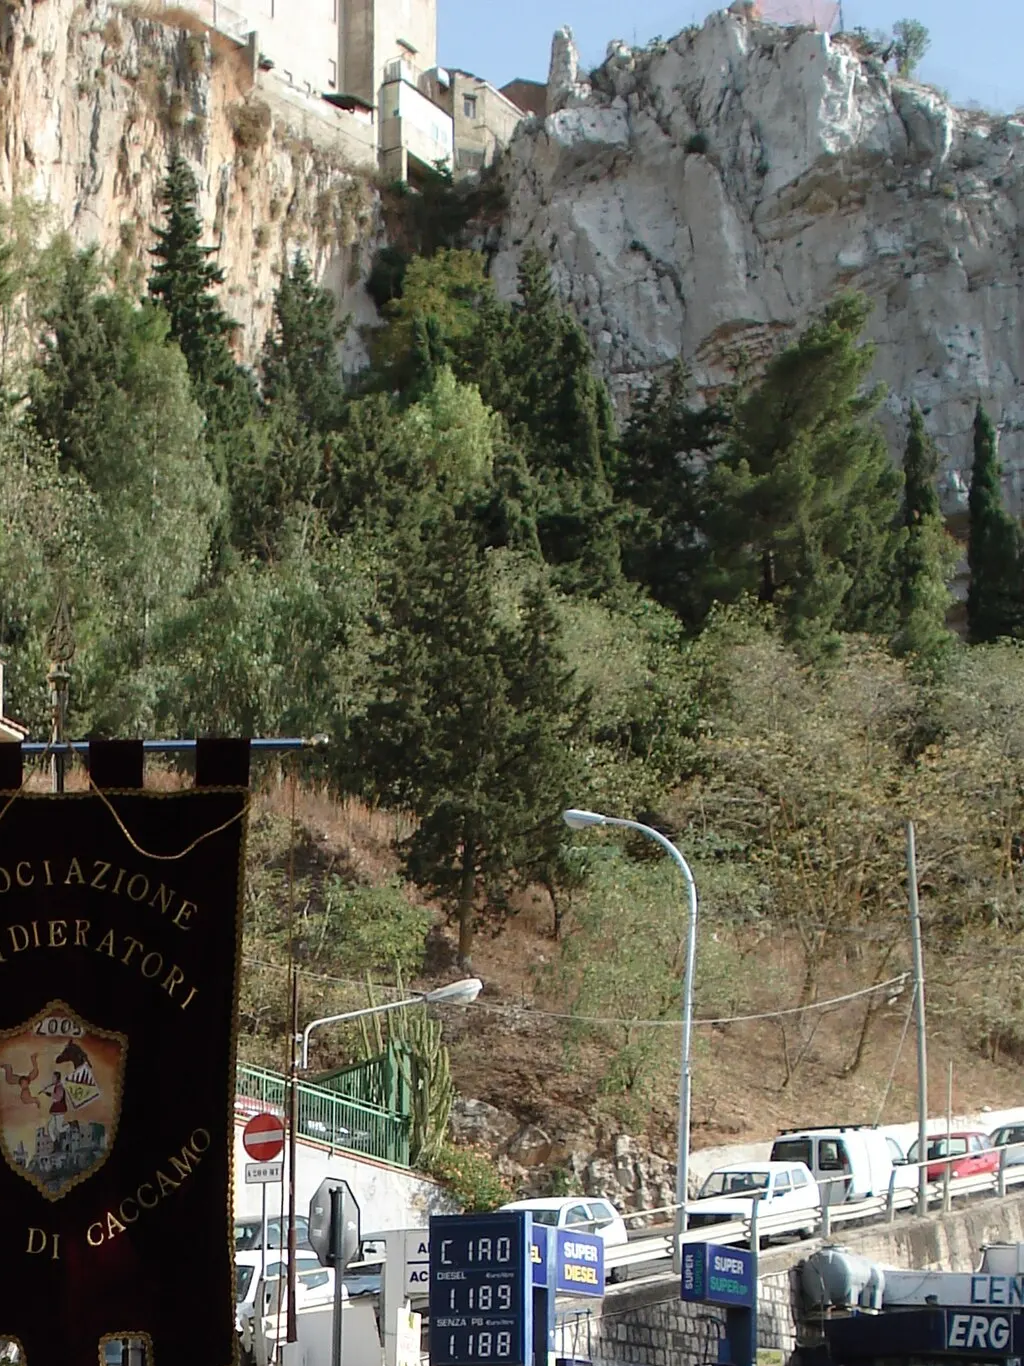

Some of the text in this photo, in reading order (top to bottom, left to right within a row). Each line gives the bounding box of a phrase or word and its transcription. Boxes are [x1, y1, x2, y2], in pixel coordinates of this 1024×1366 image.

[26, 1227, 61, 1260] DI
[86, 1127, 212, 1247] CACCAMO
[563, 1241, 598, 1263] SUPER
[436, 1271, 467, 1281] DIESEL
[563, 1263, 599, 1285] DIESEL
[684, 1254, 694, 1290] SUPER
[714, 1255, 744, 1276] SUPER
[450, 1284, 511, 1313] 1.189
[436, 1317, 467, 1328] SENZA
[948, 1313, 1010, 1349] ERG
[449, 1331, 511, 1359] 1.188
